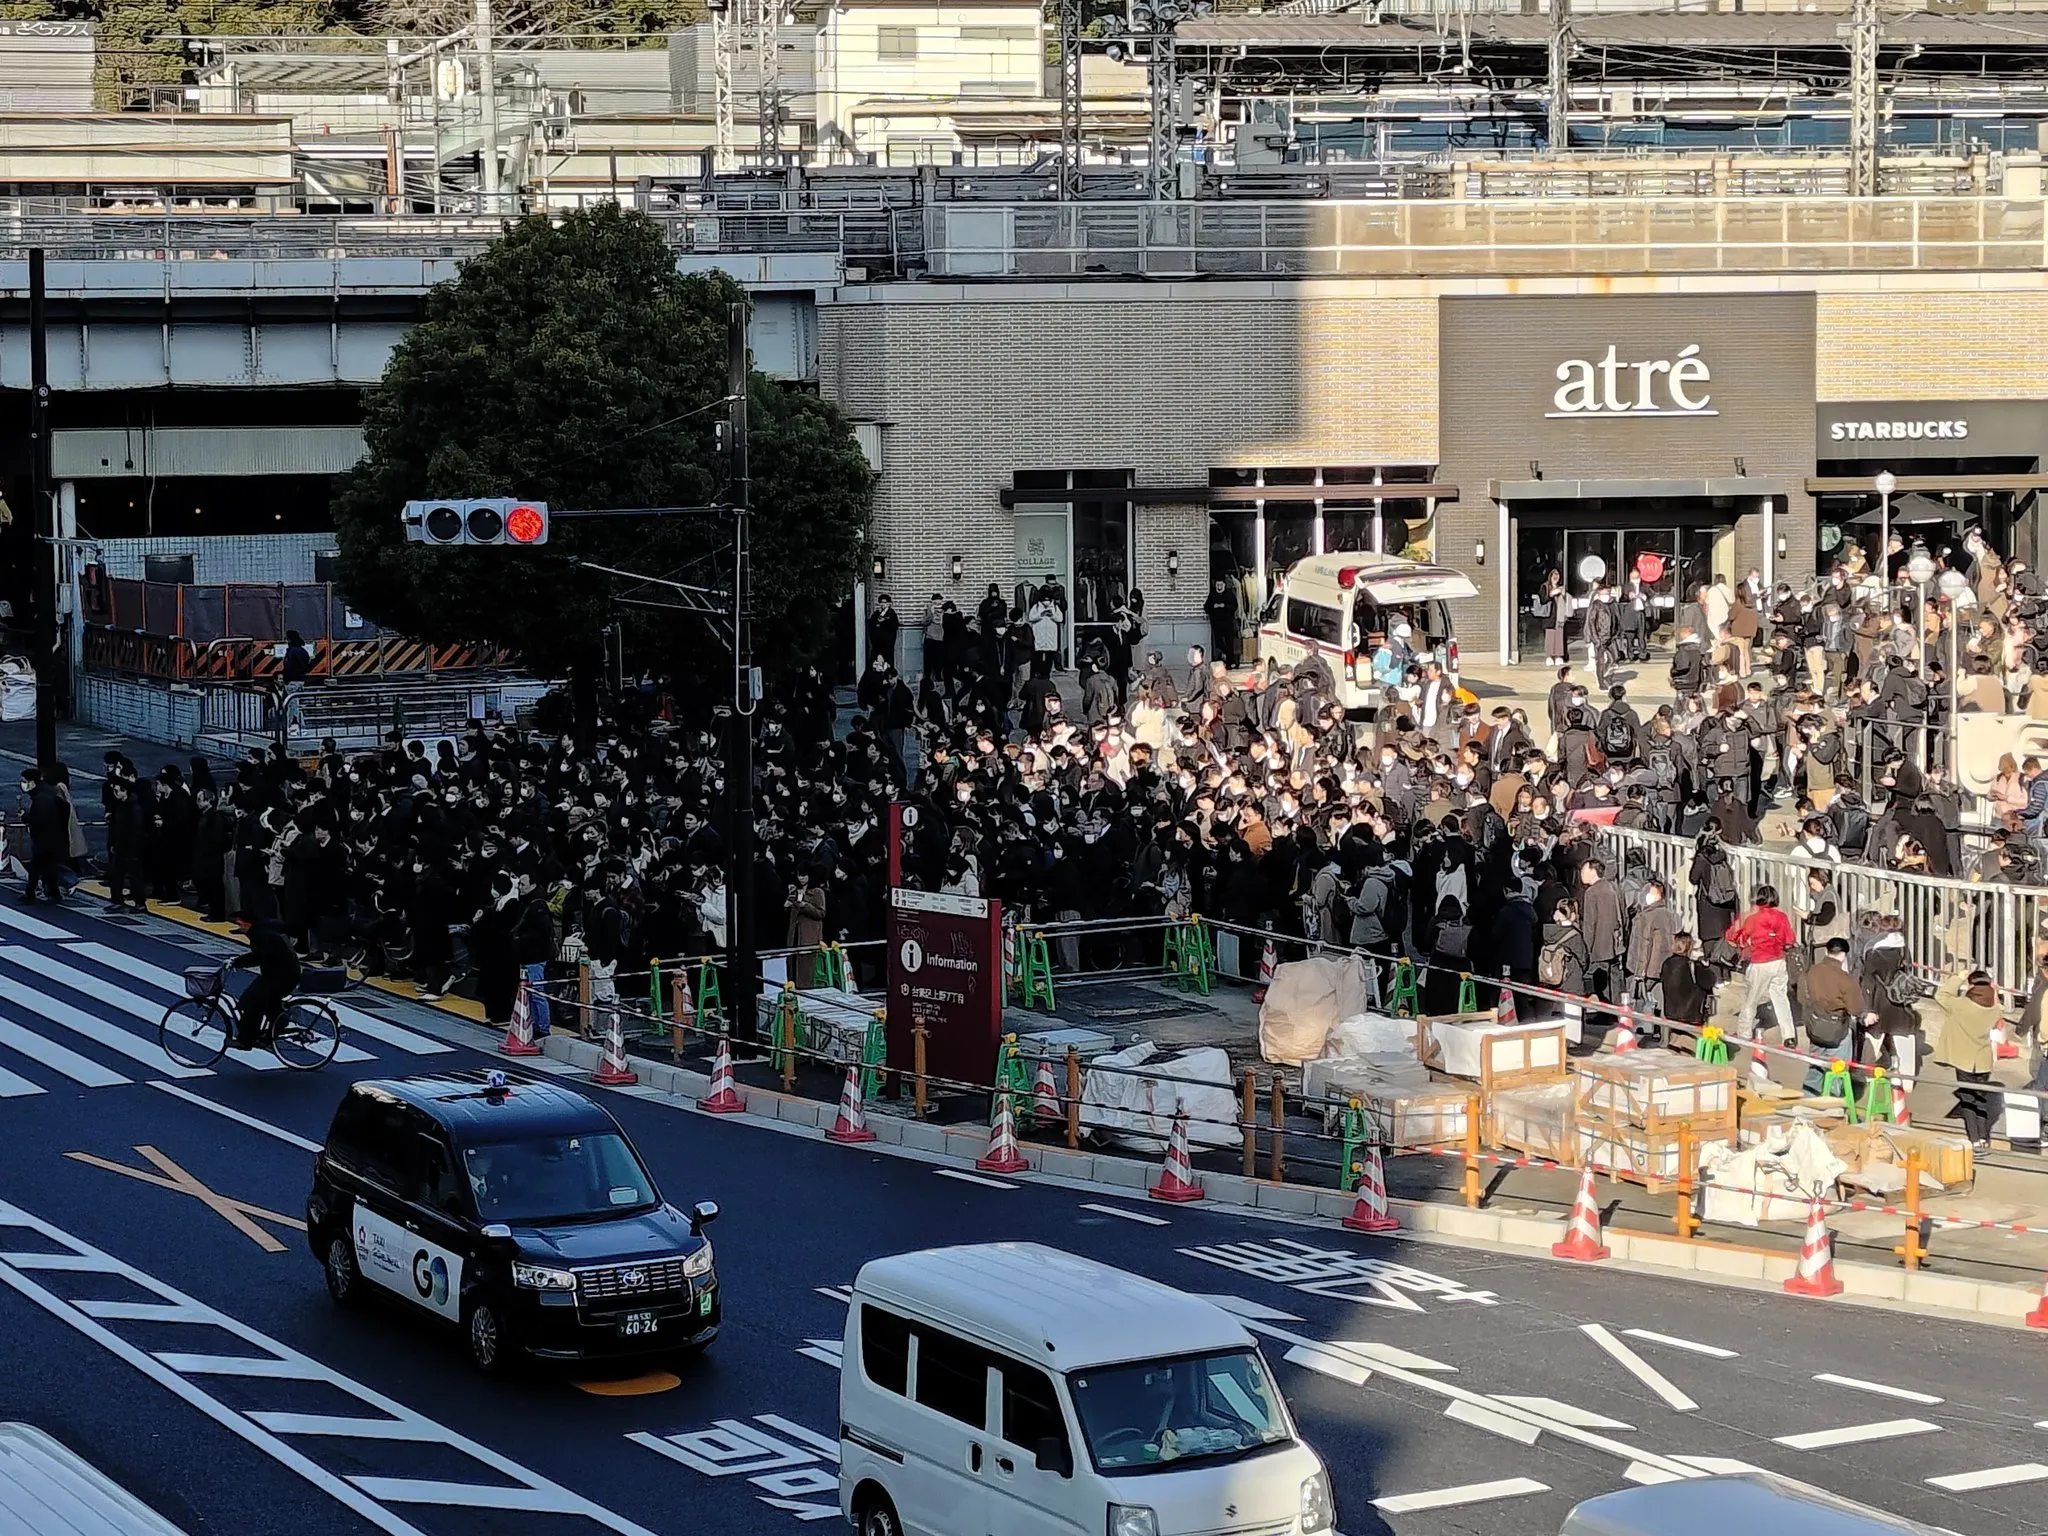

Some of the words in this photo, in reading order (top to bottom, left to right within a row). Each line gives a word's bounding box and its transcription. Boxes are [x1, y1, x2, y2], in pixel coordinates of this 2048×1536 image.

[1553, 343, 1711, 412] atré
[1831, 420, 1968, 440] STARBUCKS
[1017, 558, 1056, 566] COLLAGE
[926, 952, 978, 973] Information
[412, 1248, 450, 1307] GO
